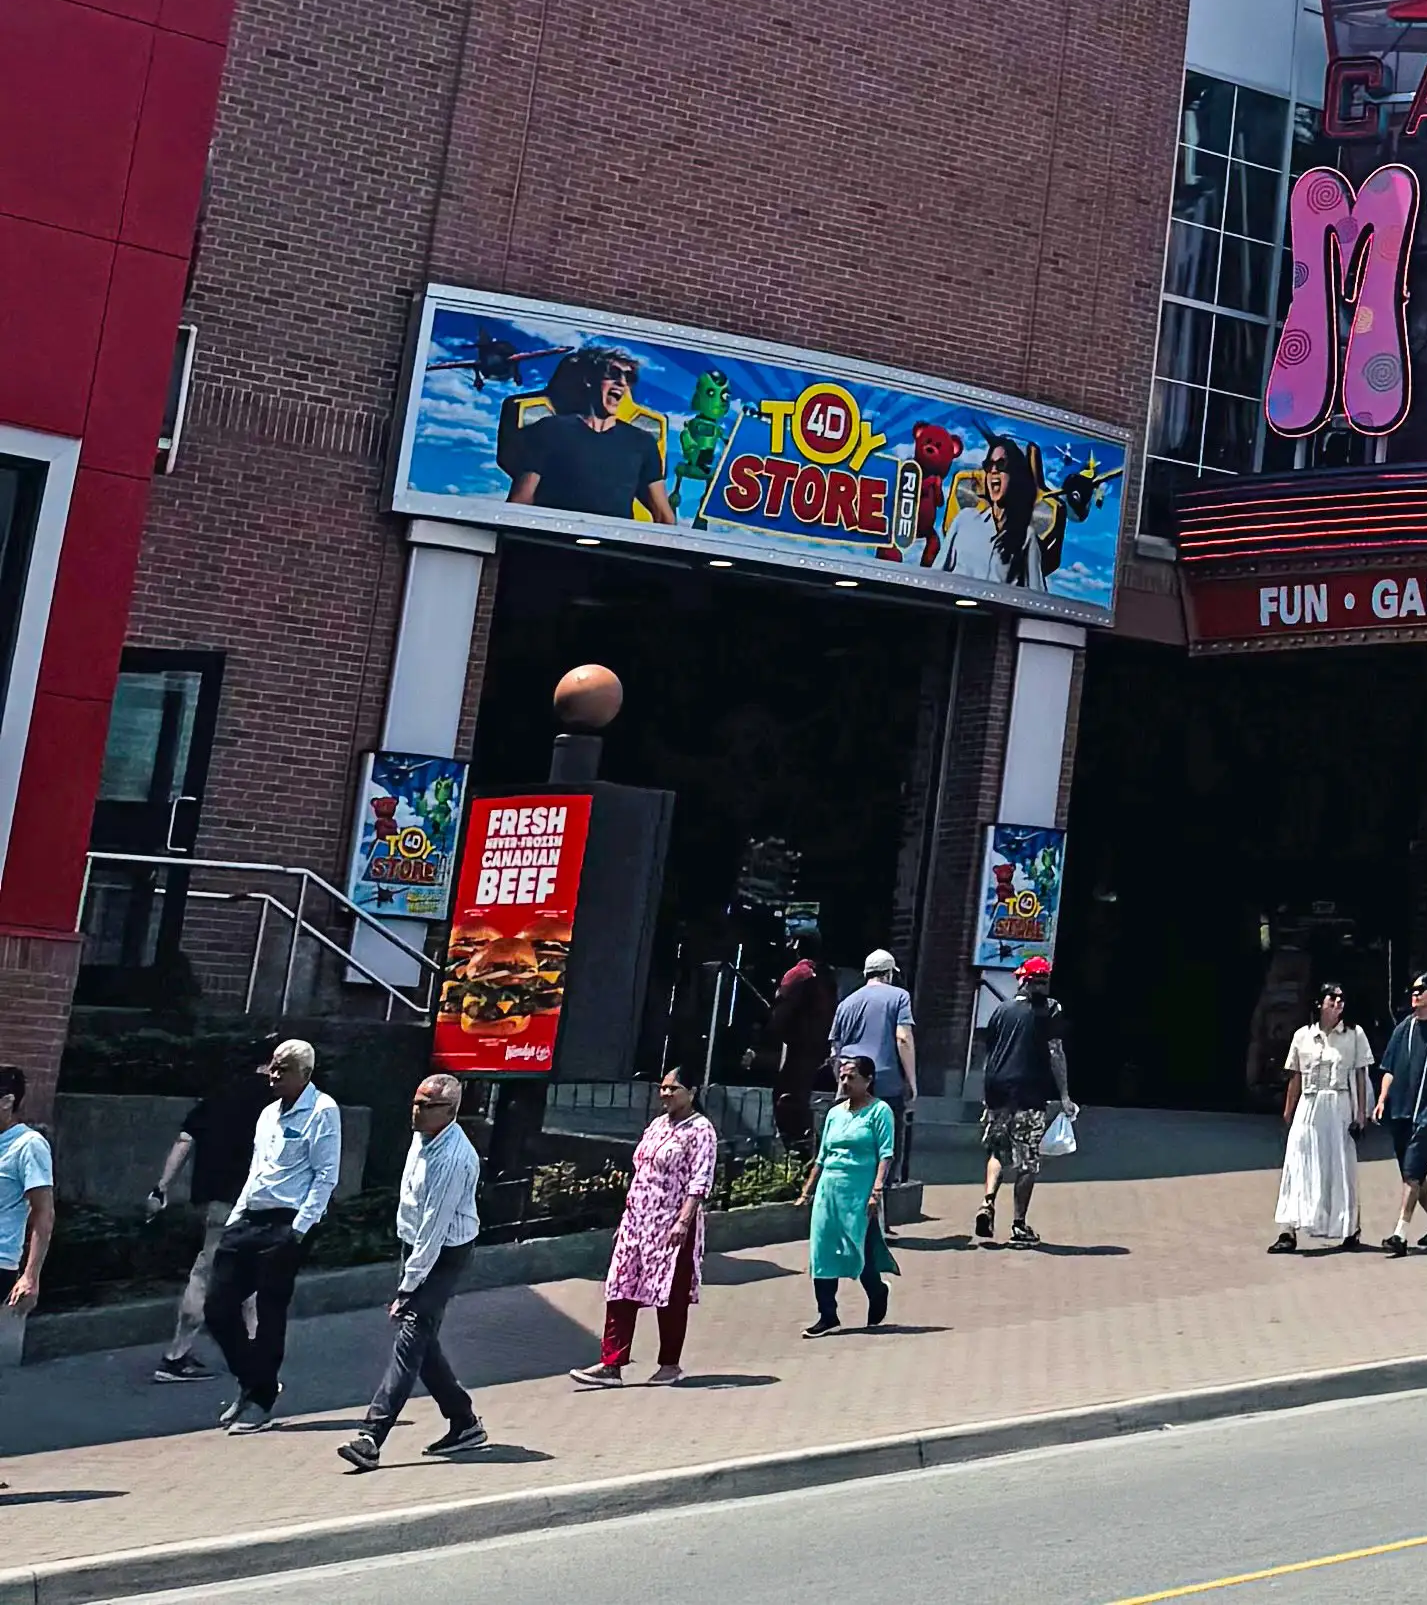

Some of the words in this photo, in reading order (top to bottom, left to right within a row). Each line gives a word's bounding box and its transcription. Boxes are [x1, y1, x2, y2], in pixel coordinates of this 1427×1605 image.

[761, 383, 886, 471] TOY
[807, 403, 845, 439] 4D
[724, 454, 888, 534] STORE
[899, 472, 916, 537] RIDE
[1260, 583, 1327, 625] FUN
[488, 807, 567, 836] FRESH
[482, 849, 561, 867] CANADIAN
[475, 867, 557, 905] BEEF
